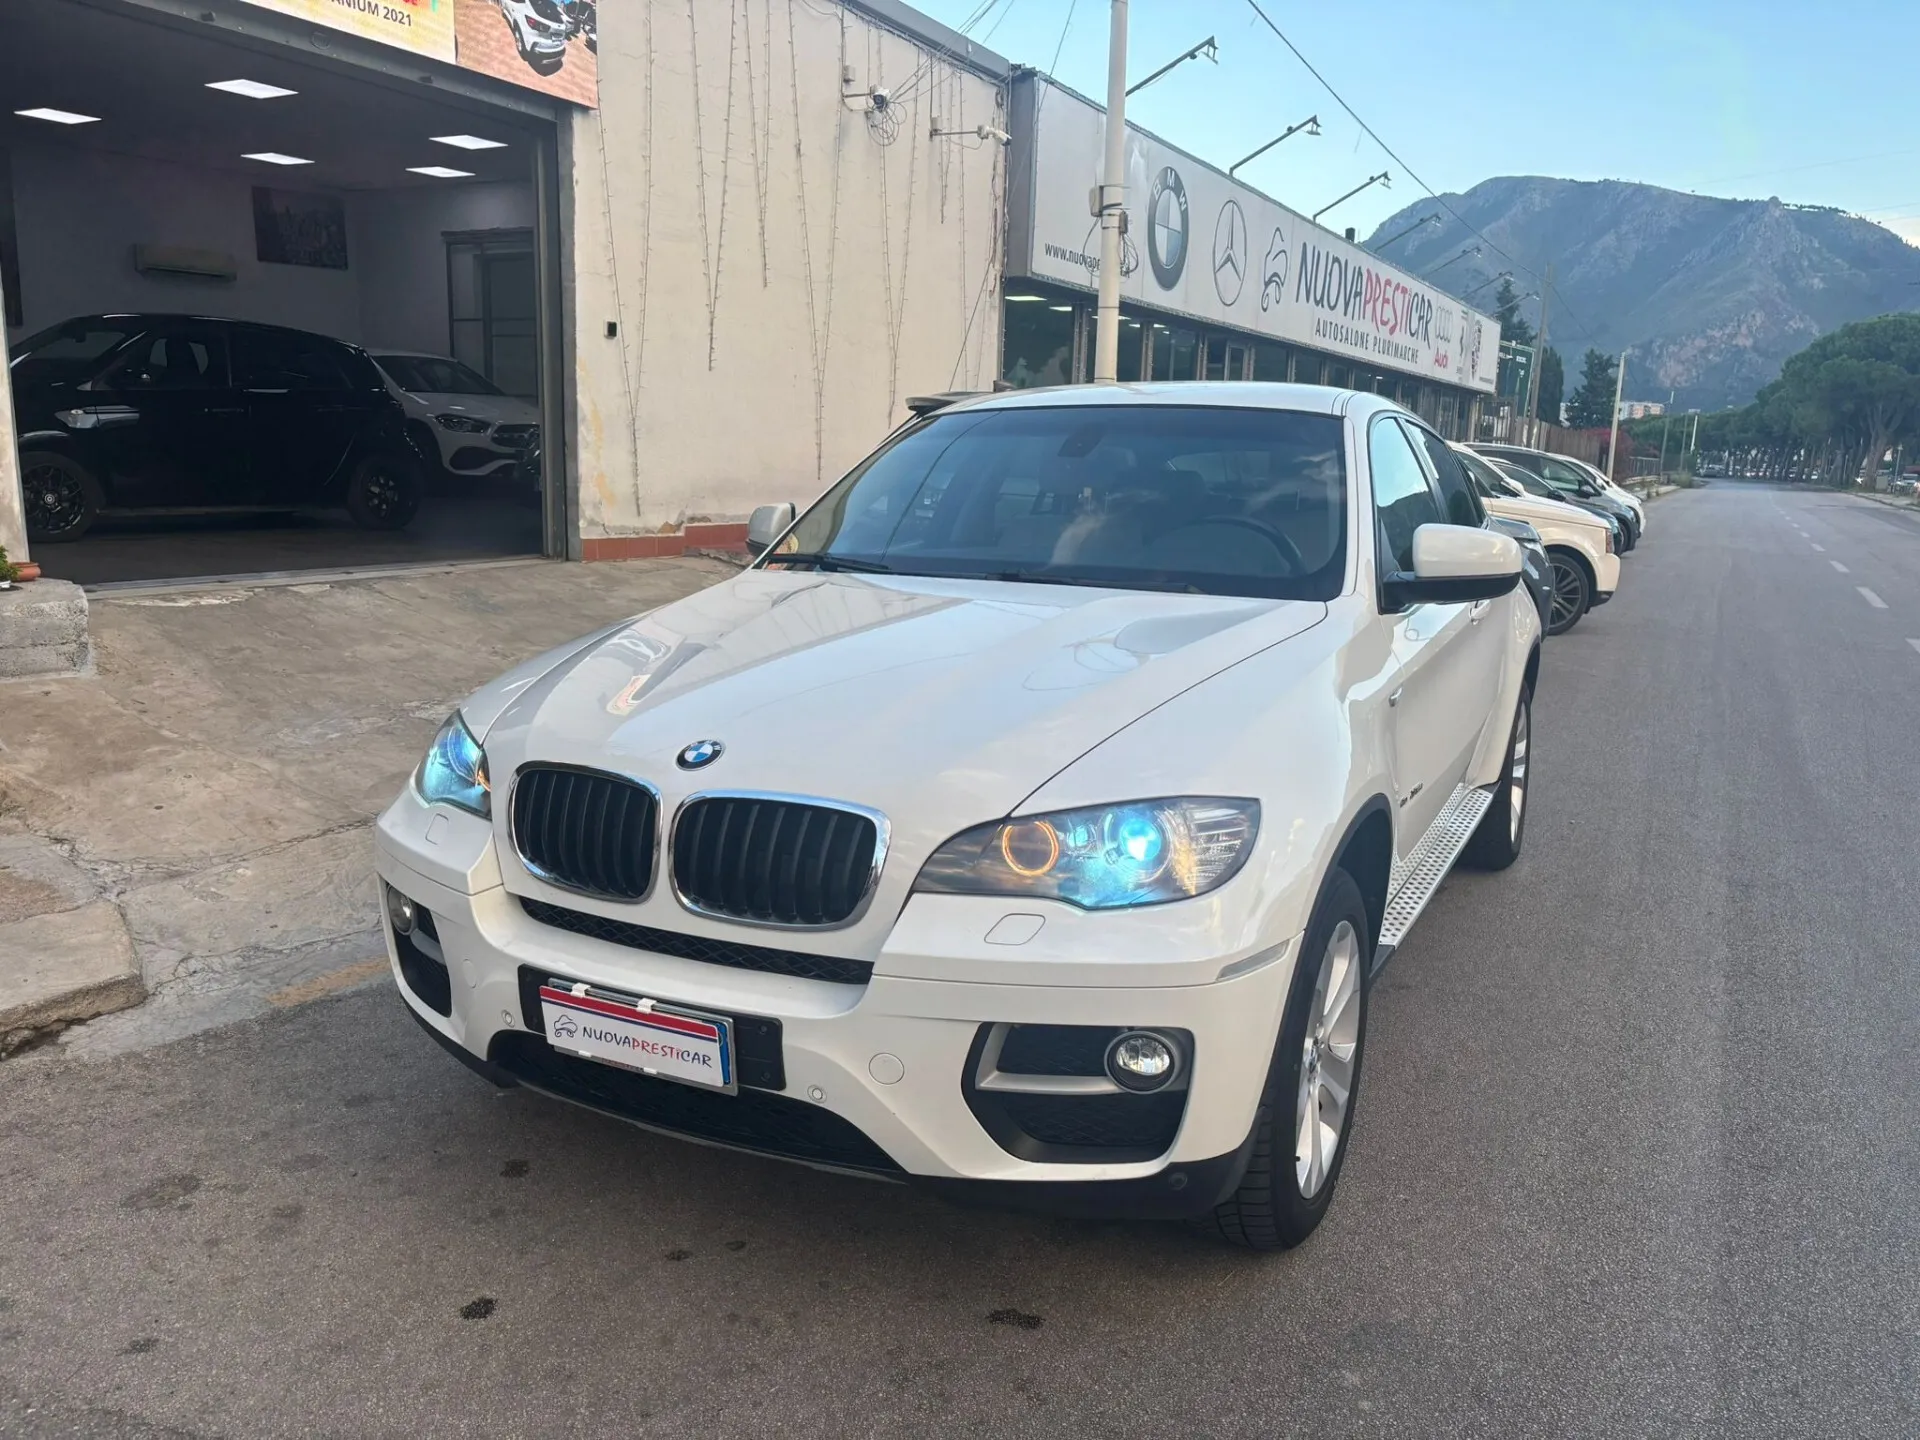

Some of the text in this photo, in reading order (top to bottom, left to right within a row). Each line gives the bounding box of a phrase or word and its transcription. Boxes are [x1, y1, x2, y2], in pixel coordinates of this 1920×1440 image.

[383, 6, 411, 27] 2021
[1153, 167, 1187, 211] BMW
[1315, 318, 1420, 364] AUTOSALONE PLURIMARCHE
